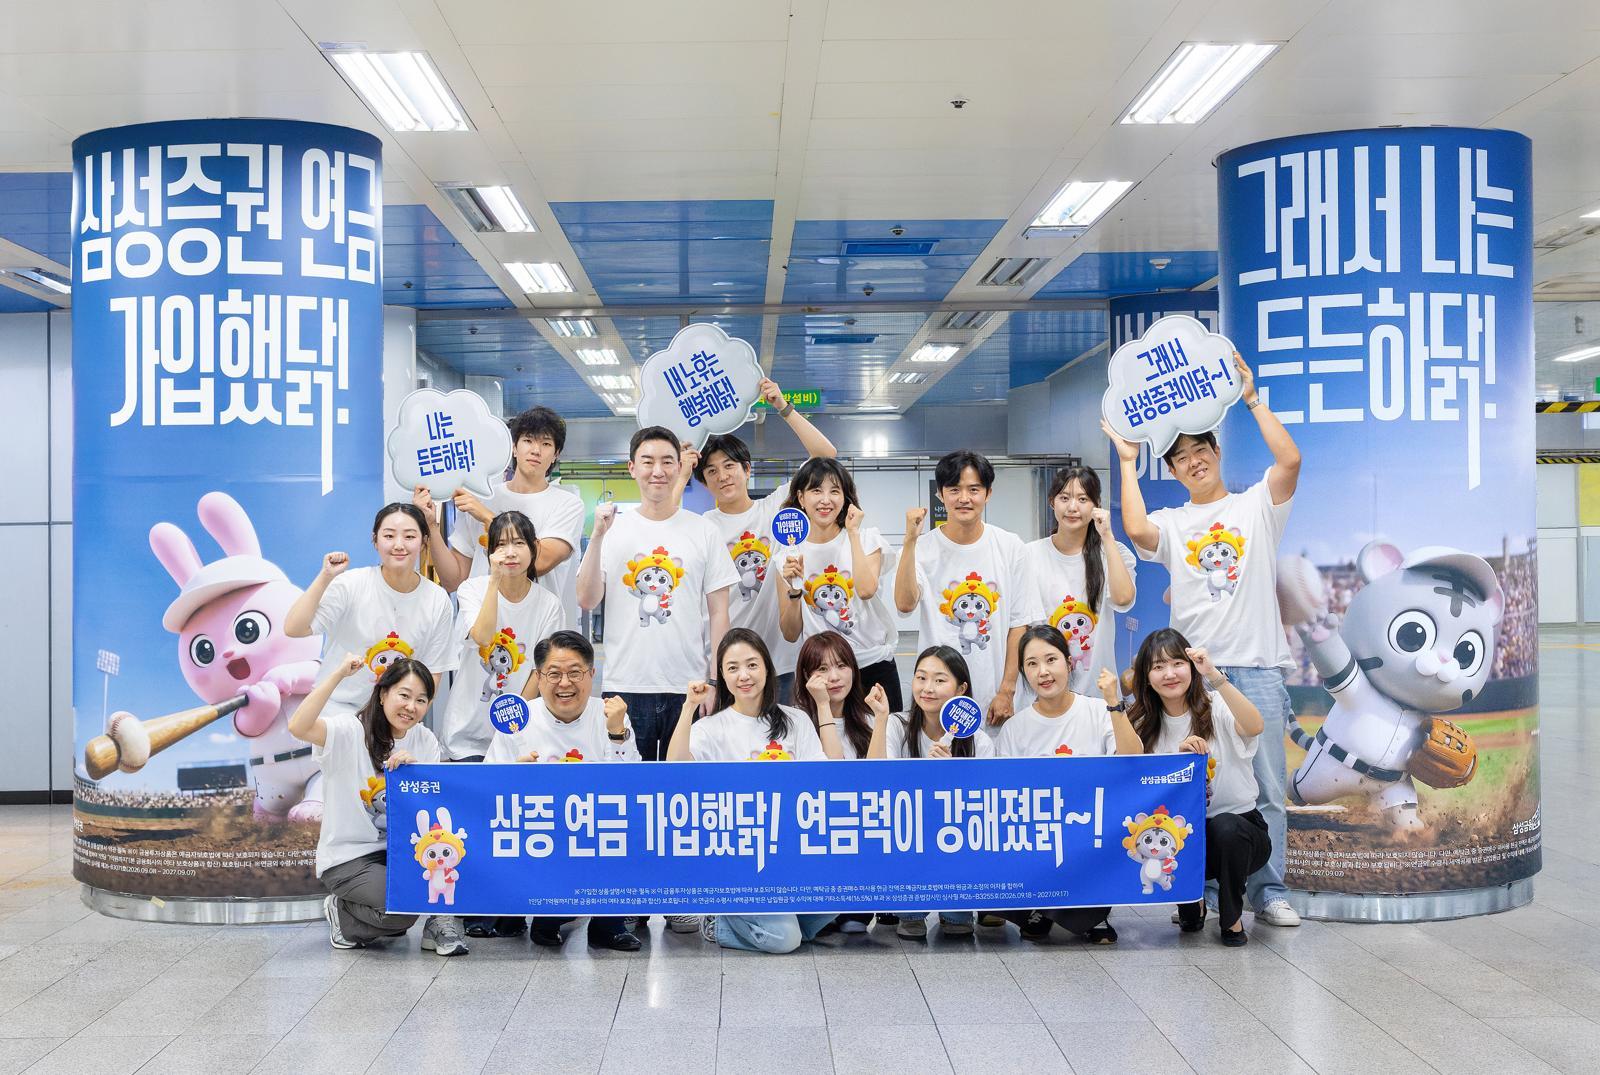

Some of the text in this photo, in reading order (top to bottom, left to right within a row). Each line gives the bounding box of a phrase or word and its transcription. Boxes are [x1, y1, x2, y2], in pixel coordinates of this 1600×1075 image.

[81, 143, 376, 285] 삼성증권 연금
[1238, 145, 1514, 286] 그래서 나는
[663, 350, 724, 398] 내 노후는
[1137, 337, 1189, 382] 그래서
[1257, 287, 1496, 491] 든든하닭!
[110, 289, 349, 497] 가입했닭!
[678, 376, 740, 428] 행복하닭!
[1122, 358, 1234, 428] 삼성증권이닭~!
[426, 411, 455, 441] 나는
[417, 439, 475, 477] 든든하닭!
[399, 780, 441, 794] 삼성증권
[489, 786, 1104, 873] 삼증 연금 가입했닭! 연금력이 강해졌닭~!
